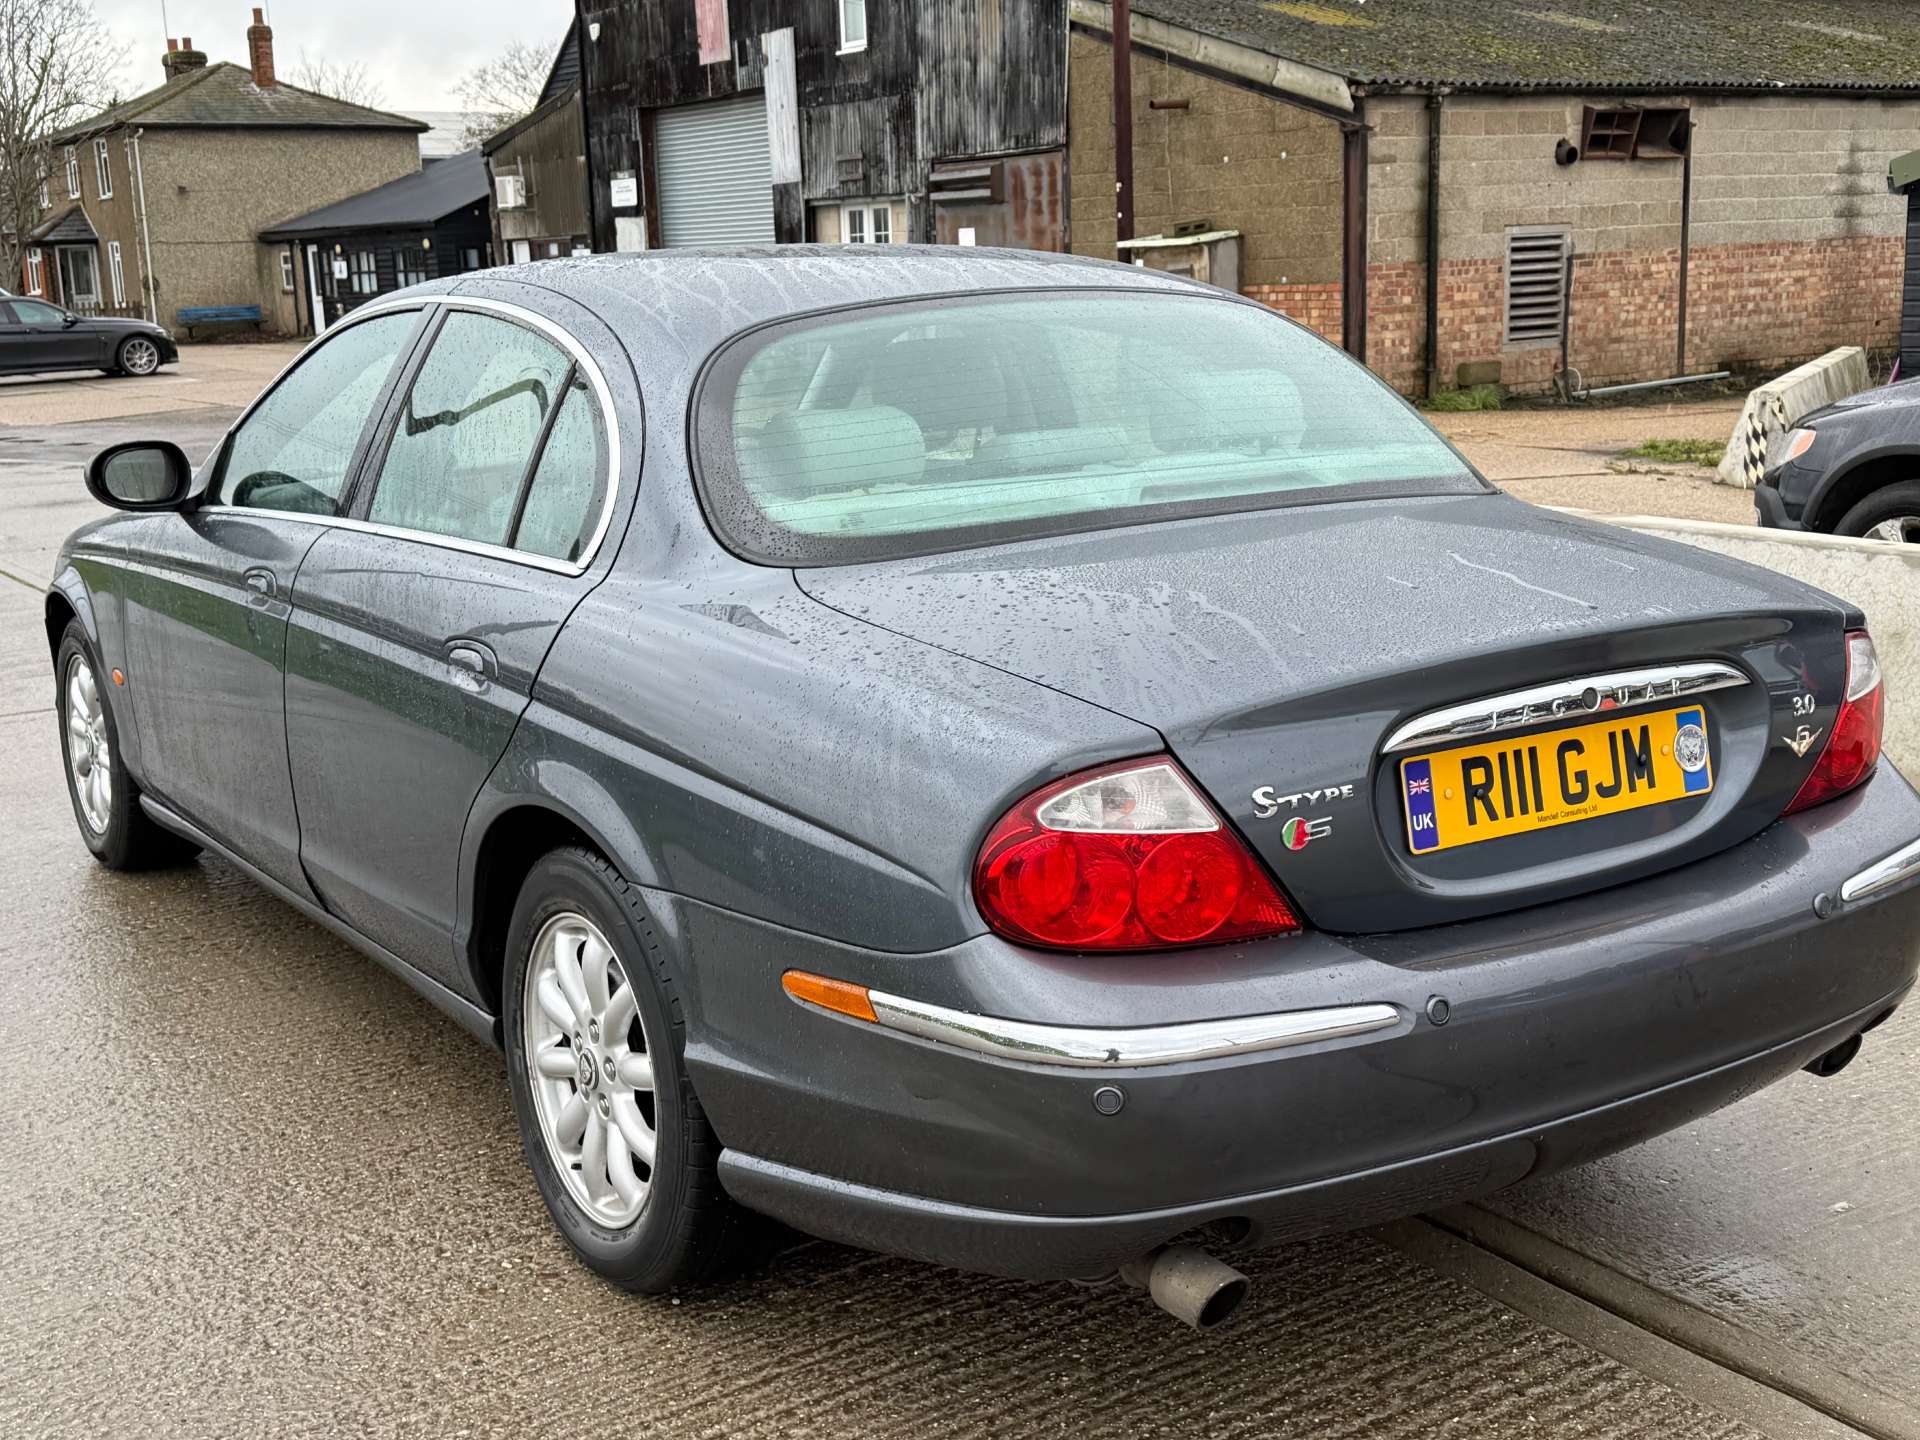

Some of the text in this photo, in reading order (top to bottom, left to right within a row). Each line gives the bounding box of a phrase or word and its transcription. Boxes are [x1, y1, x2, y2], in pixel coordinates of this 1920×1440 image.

[1488, 678, 1681, 730] JAGUAR
[1557, 724, 1657, 806] GJM
[1413, 811, 1434, 831] UK
